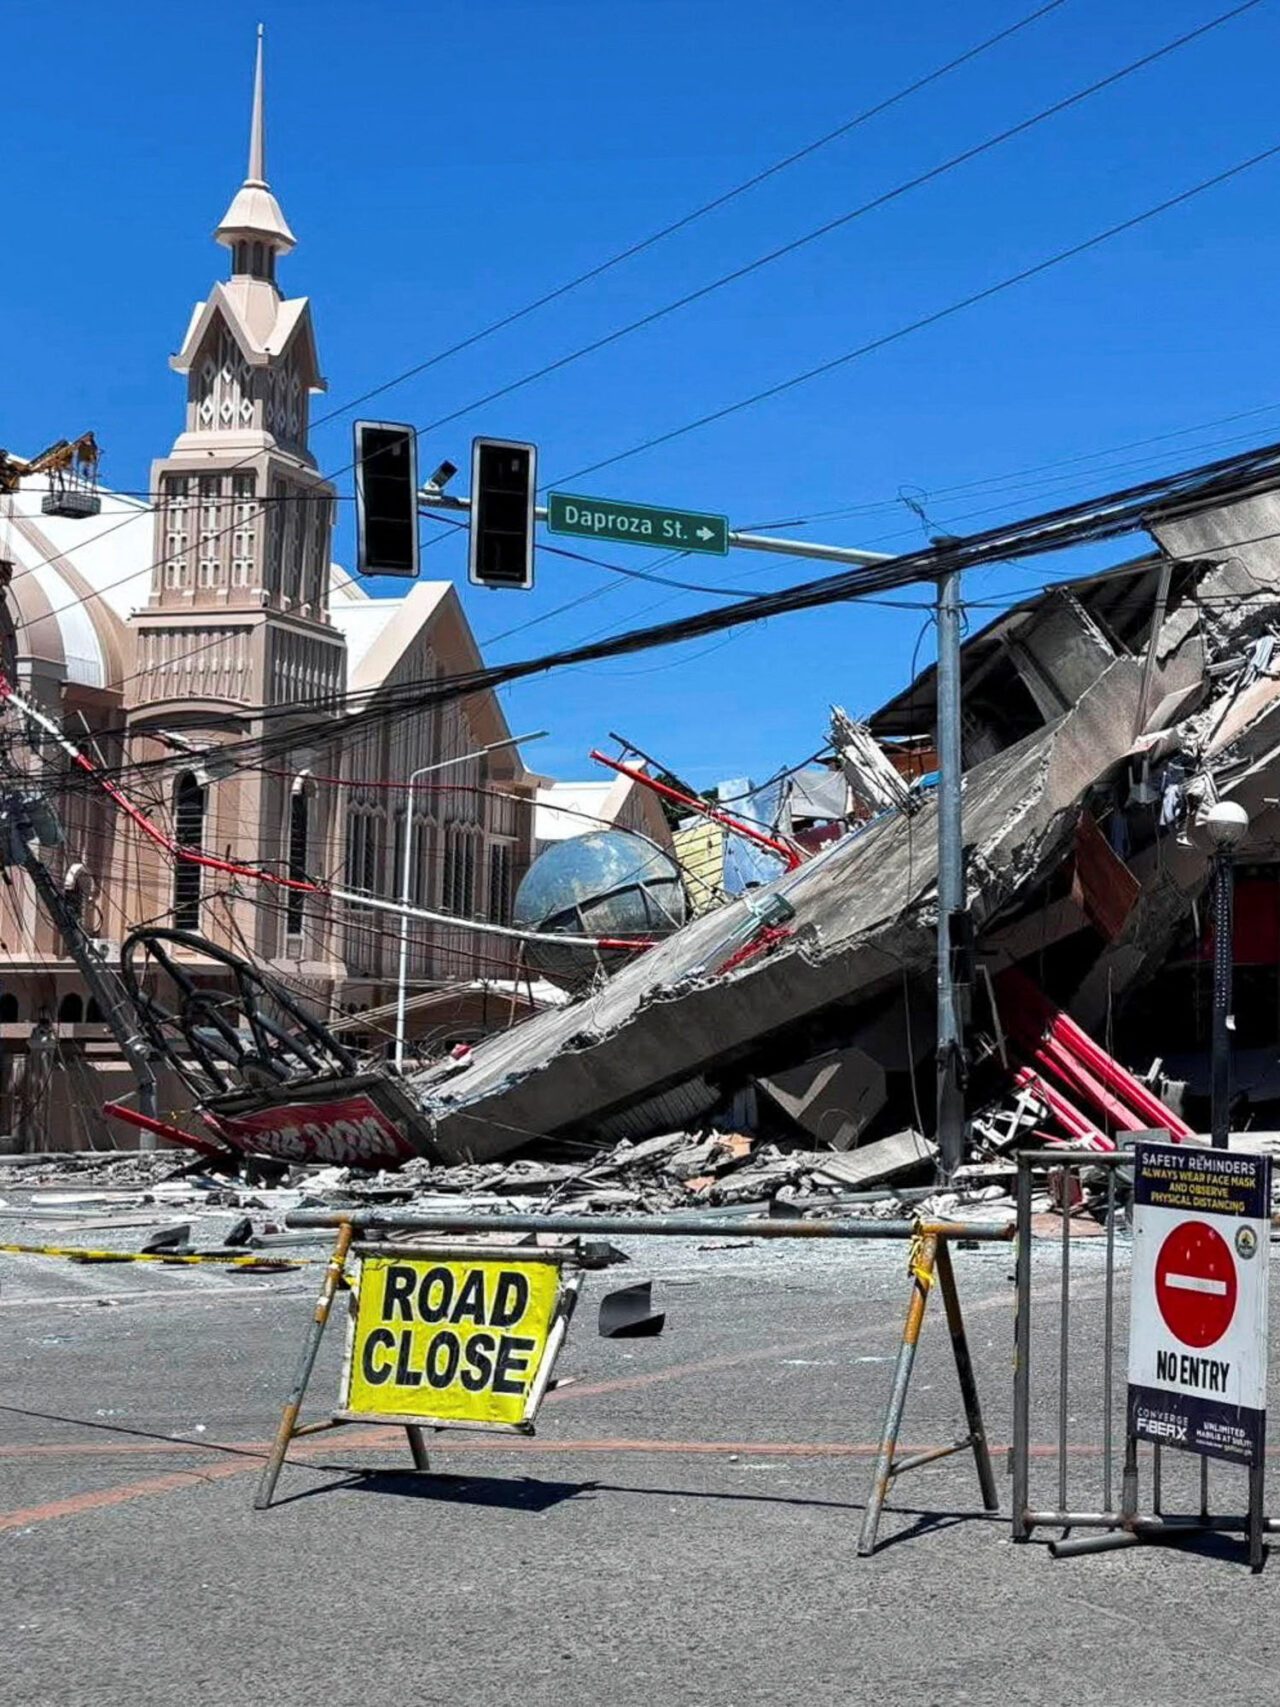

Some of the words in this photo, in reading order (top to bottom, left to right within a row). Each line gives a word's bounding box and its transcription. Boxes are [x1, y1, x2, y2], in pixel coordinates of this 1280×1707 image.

[565, 506, 652, 535] Daproza
[662, 519, 688, 539] St.
[1142, 1152, 1185, 1168] SAFETY
[1188, 1157, 1256, 1175] REMINDERS
[1141, 1167, 1178, 1180] ALWAYS
[1180, 1171, 1205, 1182] WEAR
[1206, 1174, 1230, 1186] FACE
[1231, 1176, 1256, 1188] MASK
[1169, 1182, 1187, 1192] AND
[1188, 1185, 1229, 1198] OBSERVE
[1150, 1191, 1191, 1205] PHYSICAL
[1193, 1196, 1245, 1212] DISTANCING
[382, 1265, 529, 1328] ROAD
[362, 1327, 535, 1394] CLOSE
[1156, 1350, 1178, 1382] NO
[1180, 1354, 1230, 1393] ENTRY
[1136, 1406, 1189, 1427] CONVERGE
[1203, 1421, 1246, 1438] UNLIMITED
